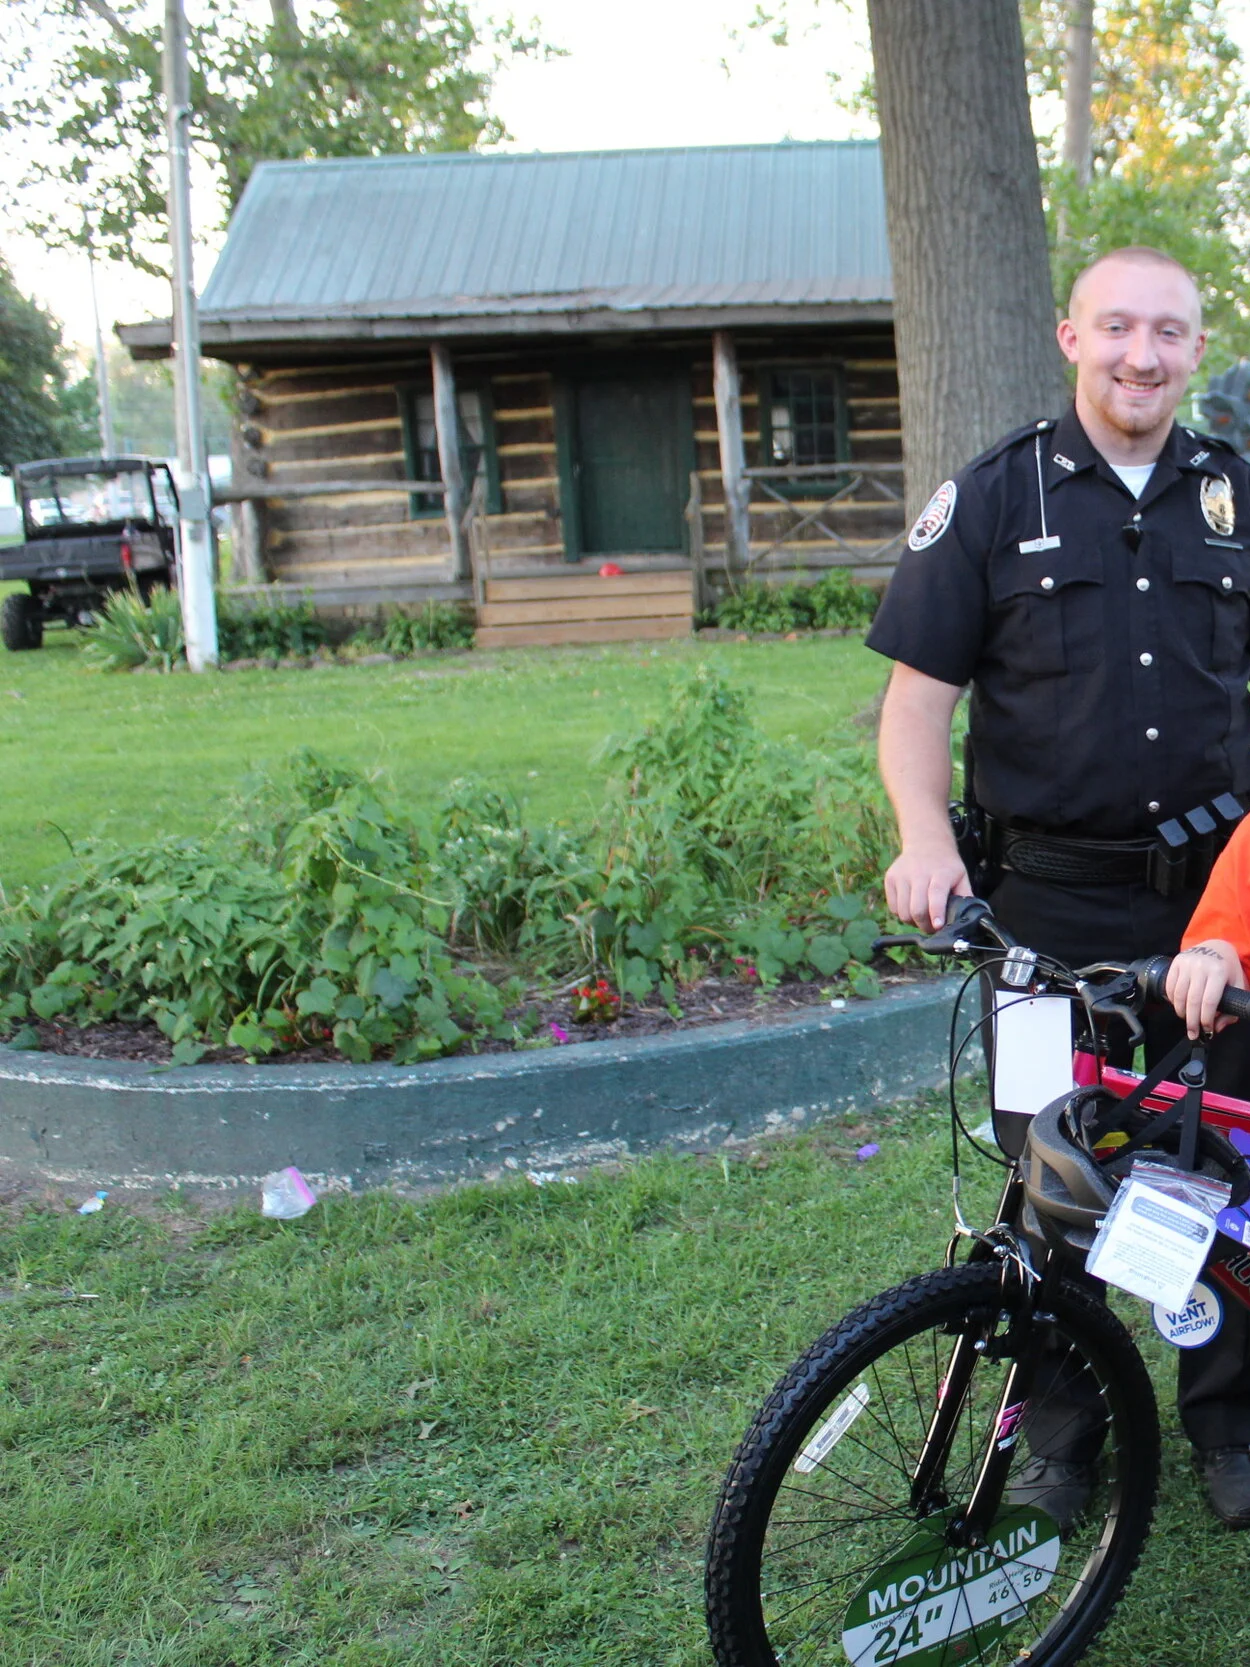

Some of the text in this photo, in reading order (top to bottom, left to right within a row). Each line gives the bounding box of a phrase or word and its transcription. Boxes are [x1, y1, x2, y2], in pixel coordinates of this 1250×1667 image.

[1165, 1301, 1206, 1326] VENT
[1169, 1315, 1216, 1339] AIRFLOW!
[868, 1520, 1037, 1616] MOUNTAIN
[874, 1604, 943, 1664] 24"
